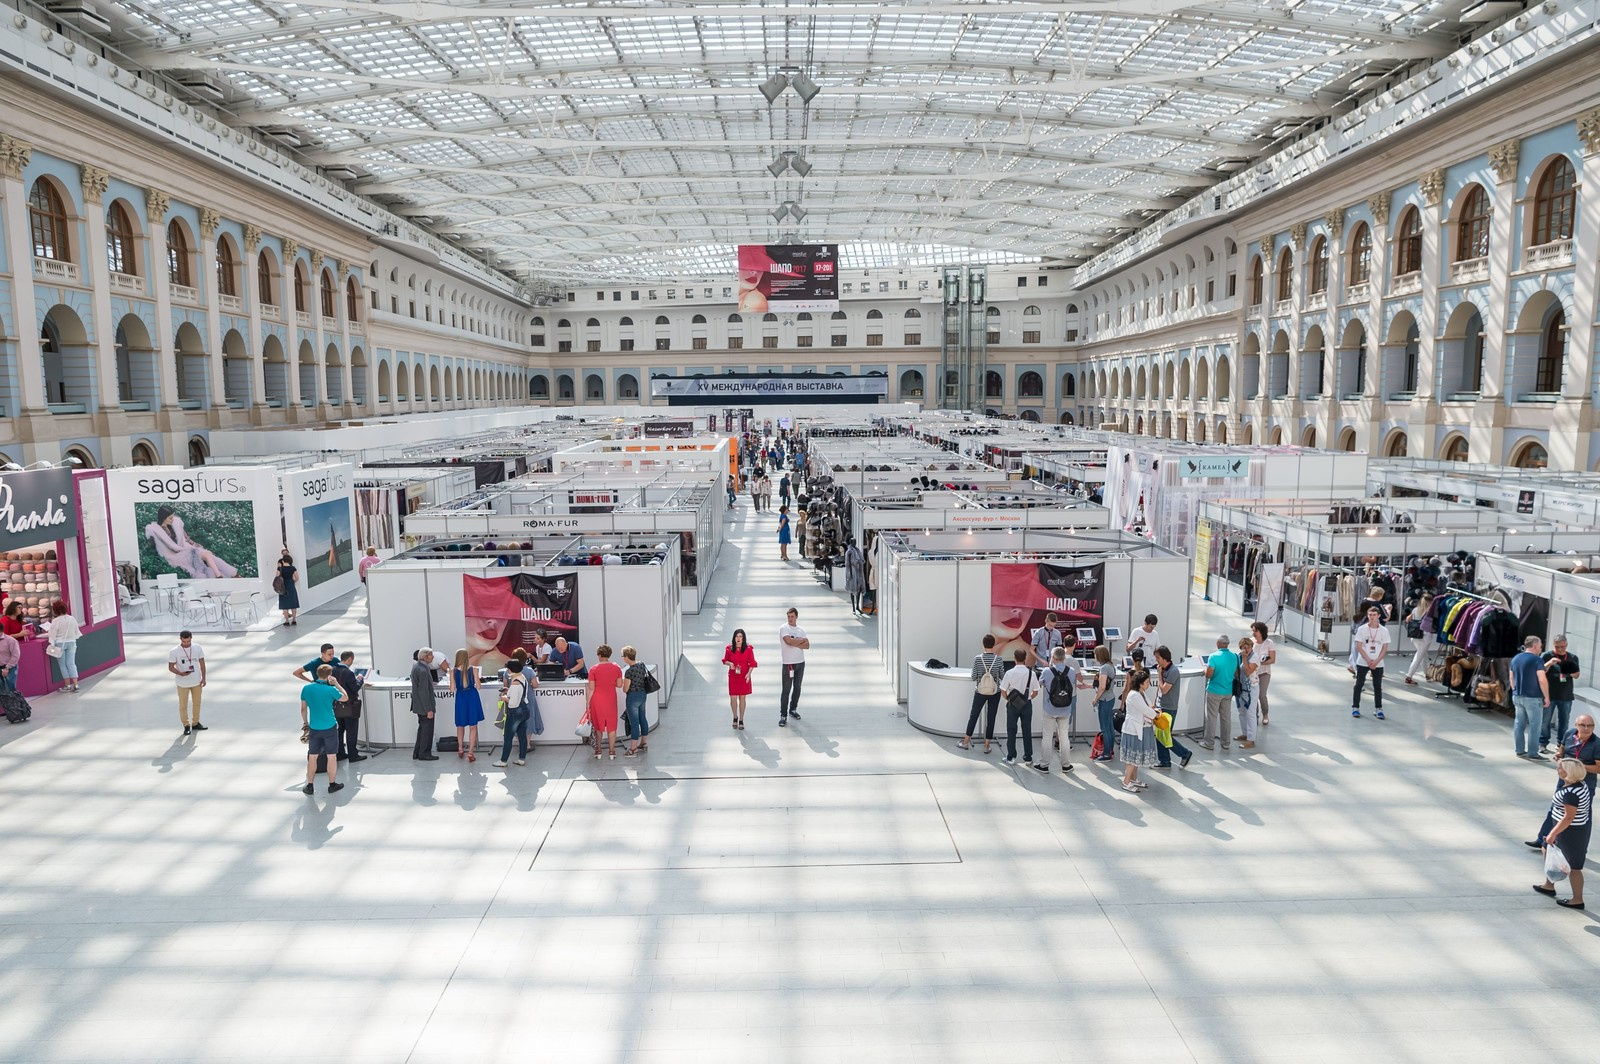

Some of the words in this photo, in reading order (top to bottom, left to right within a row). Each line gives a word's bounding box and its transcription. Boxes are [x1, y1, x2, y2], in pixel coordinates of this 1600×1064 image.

[770, 263, 791, 273] ШАПО
[792, 265, 807, 273] 2017
[698, 383, 709, 391] XV
[712, 383, 793, 392] МЕЖДУНАРОДНАЯ
[796, 382, 844, 391] ВЫСТАВКА
[1046, 597, 1078, 611] ШАПО
[1078, 600, 1097, 610] 2017
[520, 607, 551, 621] ШАПО
[552, 610, 572, 621] 2017
[535, 689, 585, 697] ГИСТРАЦИЯ
